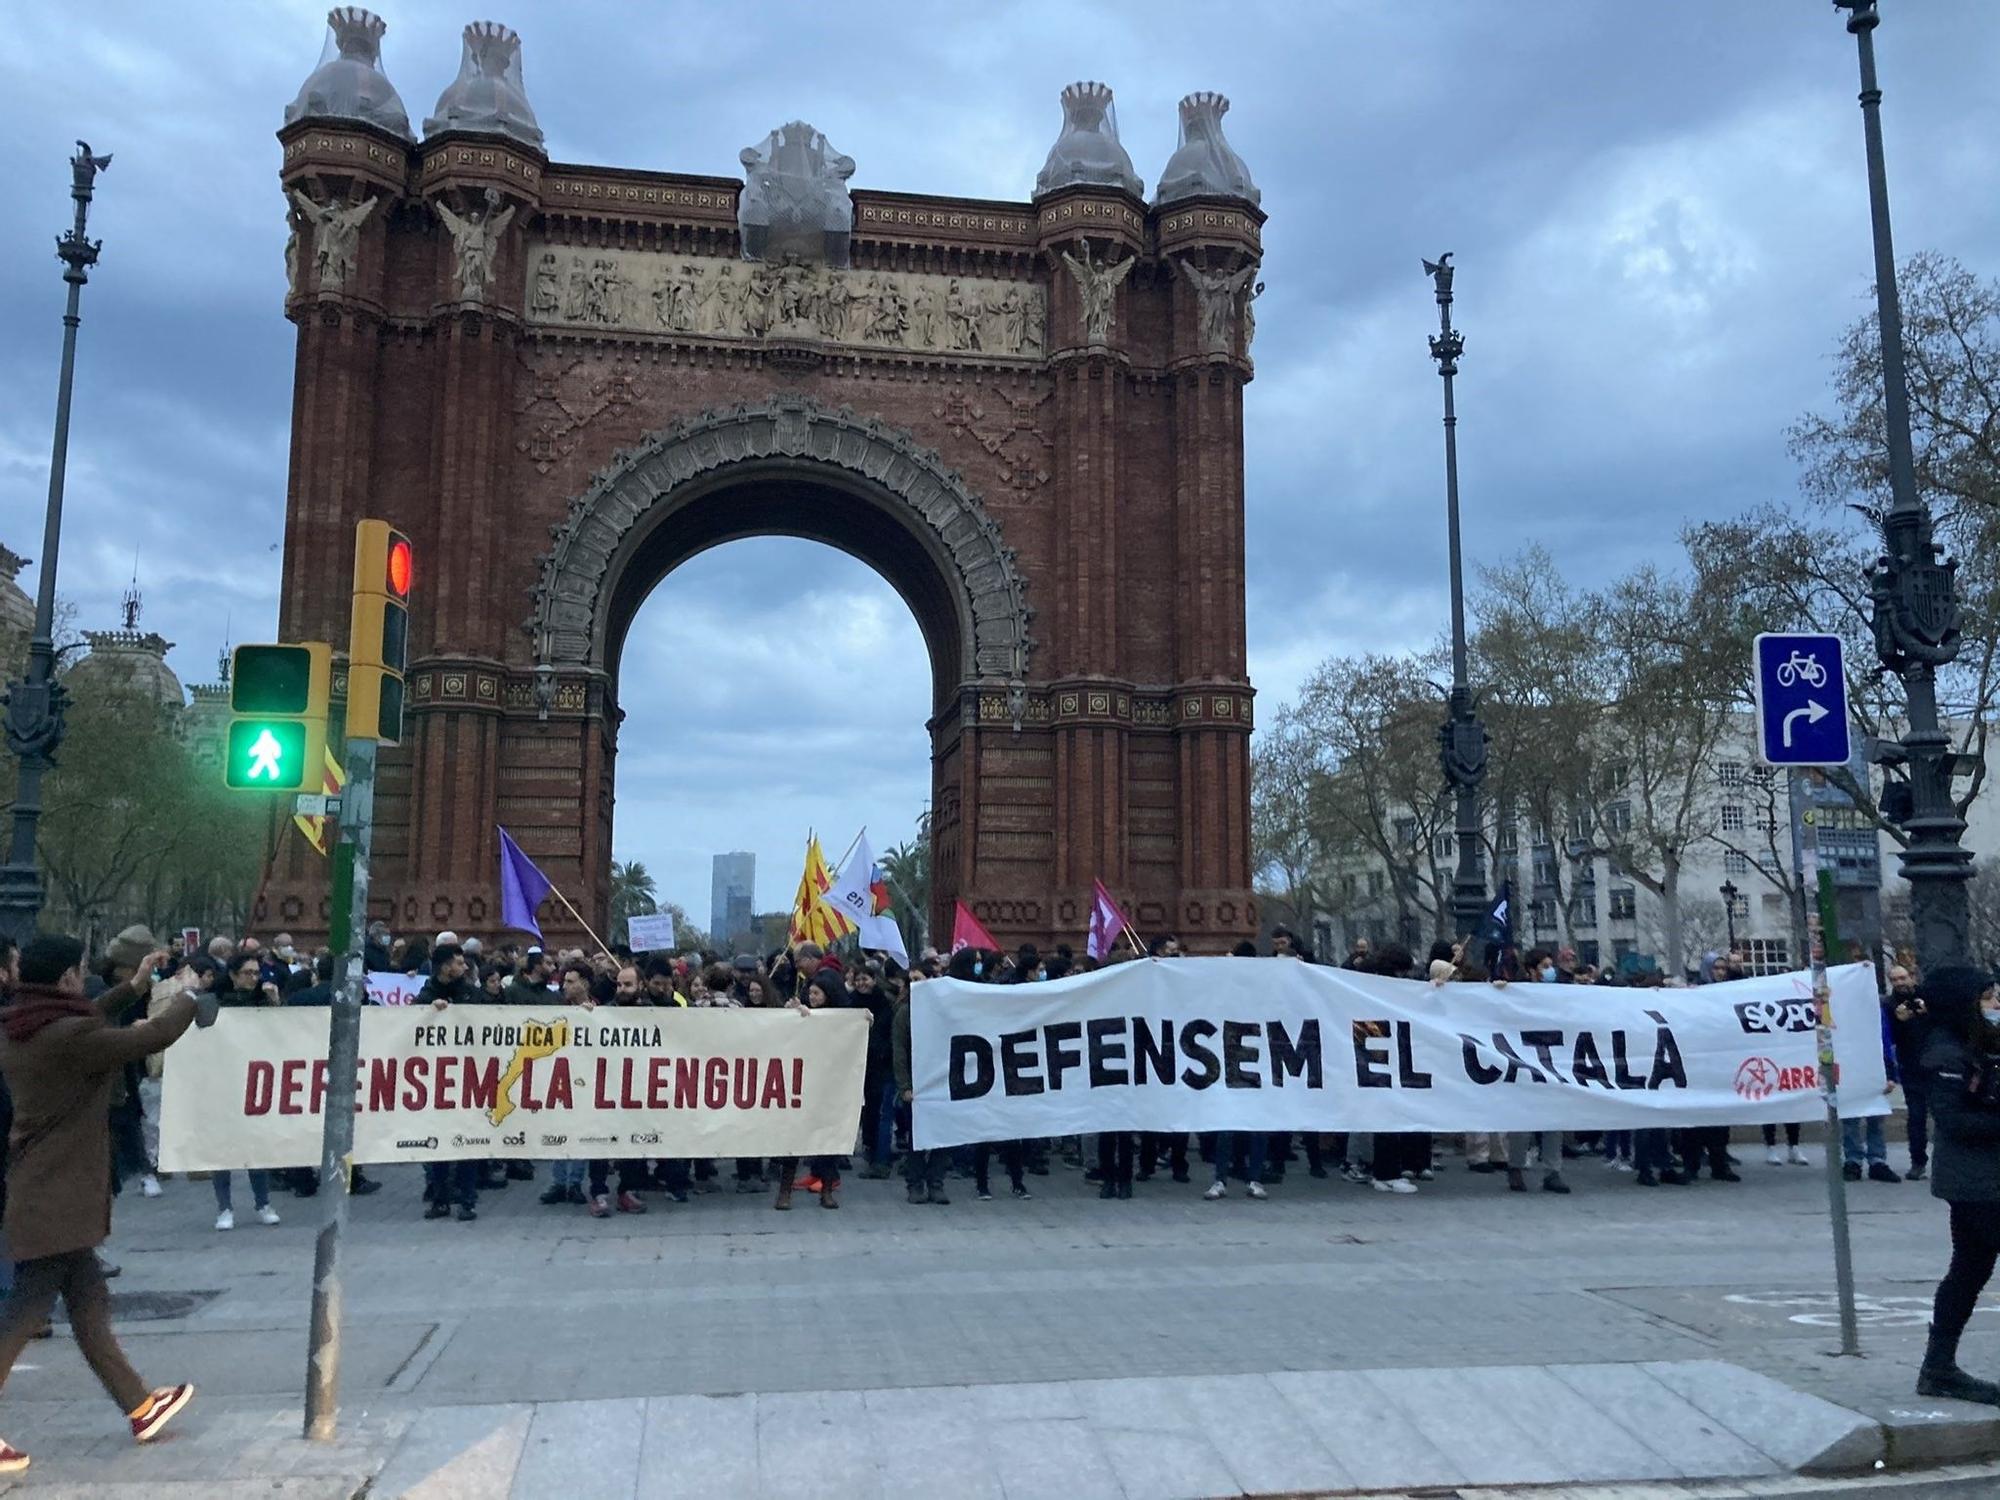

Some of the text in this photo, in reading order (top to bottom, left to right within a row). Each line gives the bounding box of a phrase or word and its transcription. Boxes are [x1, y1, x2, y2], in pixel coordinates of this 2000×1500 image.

[415, 1023, 662, 1047] PER LA PÚBLICA I EL CATALÀ
[949, 1009, 1687, 1101] DEFENSEM EL CATALÀ
[520, 1056, 573, 1109] LA
[594, 1056, 804, 1109] LLENGUA!
[1778, 1063, 1840, 1091] ARR
